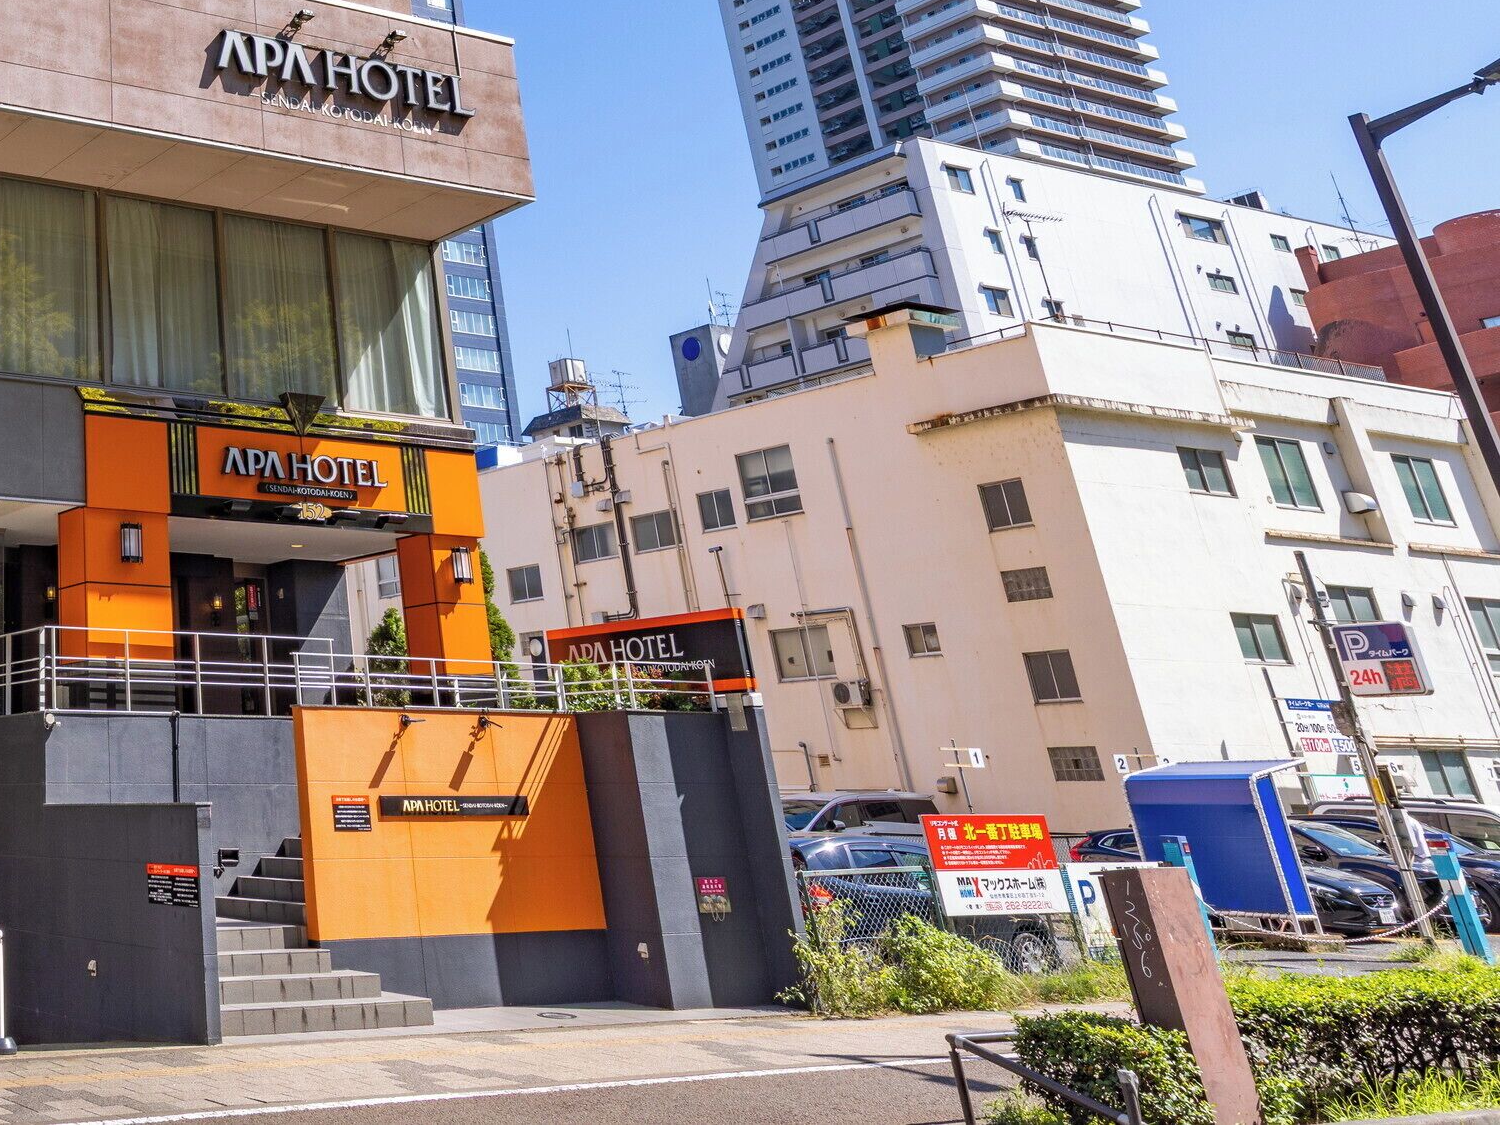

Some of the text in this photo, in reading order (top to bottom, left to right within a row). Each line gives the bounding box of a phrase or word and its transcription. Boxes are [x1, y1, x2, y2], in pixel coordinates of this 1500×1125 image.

[217, 29, 477, 118] APA HOTEL
[222, 446, 388, 488] APA HOTEL
[568, 633, 685, 663] APA HOTEL
[1368, 648, 1410, 658] タイムパーク
[1350, 668, 1384, 686] 24h
[973, 752, 979, 764] 1
[1118, 758, 1126, 770] 2
[1353, 760, 1360, 772] 5
[1390, 762, 1398, 773] 6
[403, 799, 425, 812] APA
[425, 799, 460, 812] HOTEL
[963, 823, 1044, 841] 北一番丁駐車場
[959, 888, 976, 898] HOME
[1077, 879, 1096, 917] P
